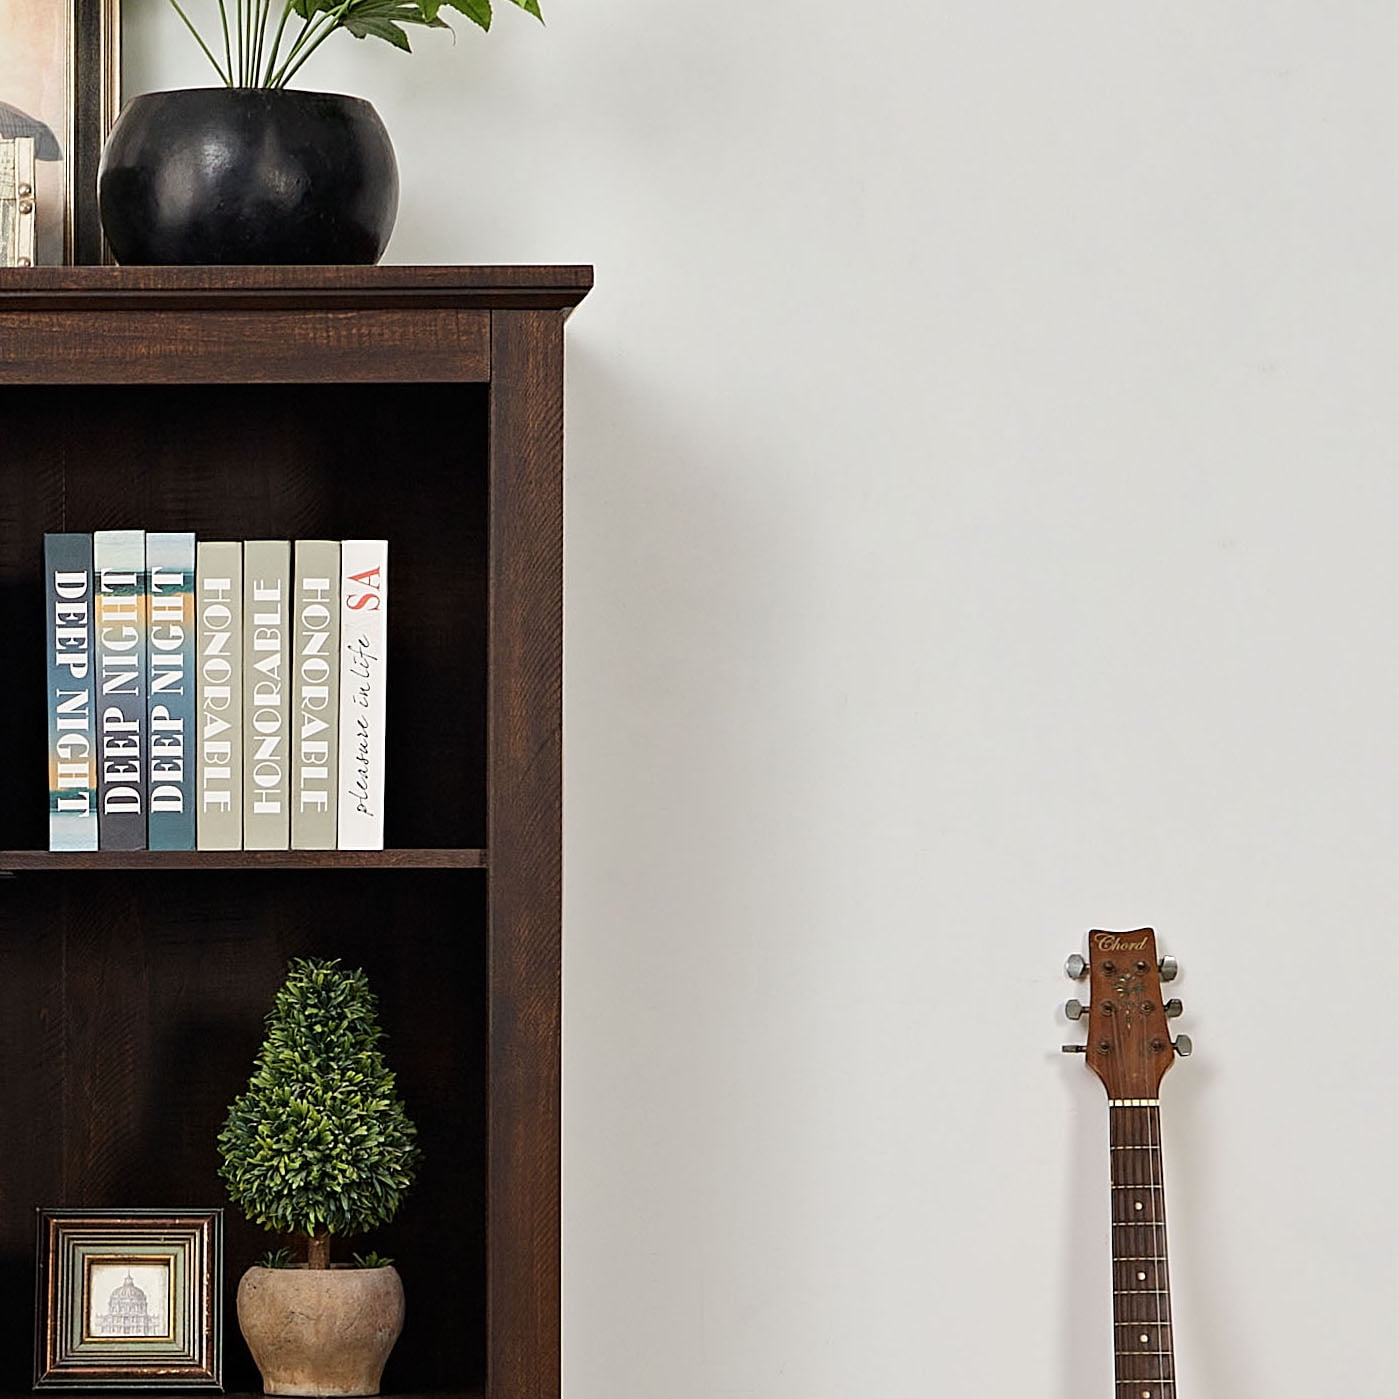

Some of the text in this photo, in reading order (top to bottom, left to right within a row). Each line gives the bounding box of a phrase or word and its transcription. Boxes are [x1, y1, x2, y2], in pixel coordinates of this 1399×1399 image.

[54, 570, 90, 818] DEEP NIGHT
[100, 567, 141, 815] DEEP NIGHT
[150, 566, 185, 814] DEEP NIGHT
[202, 577, 232, 814] HONORABLE
[252, 578, 282, 814] HONORABLE
[299, 577, 331, 814] HONORABLE
[346, 566, 381, 612] SA
[347, 632, 379, 817] pleasure in life
[1094, 933, 1149, 951] Chord
